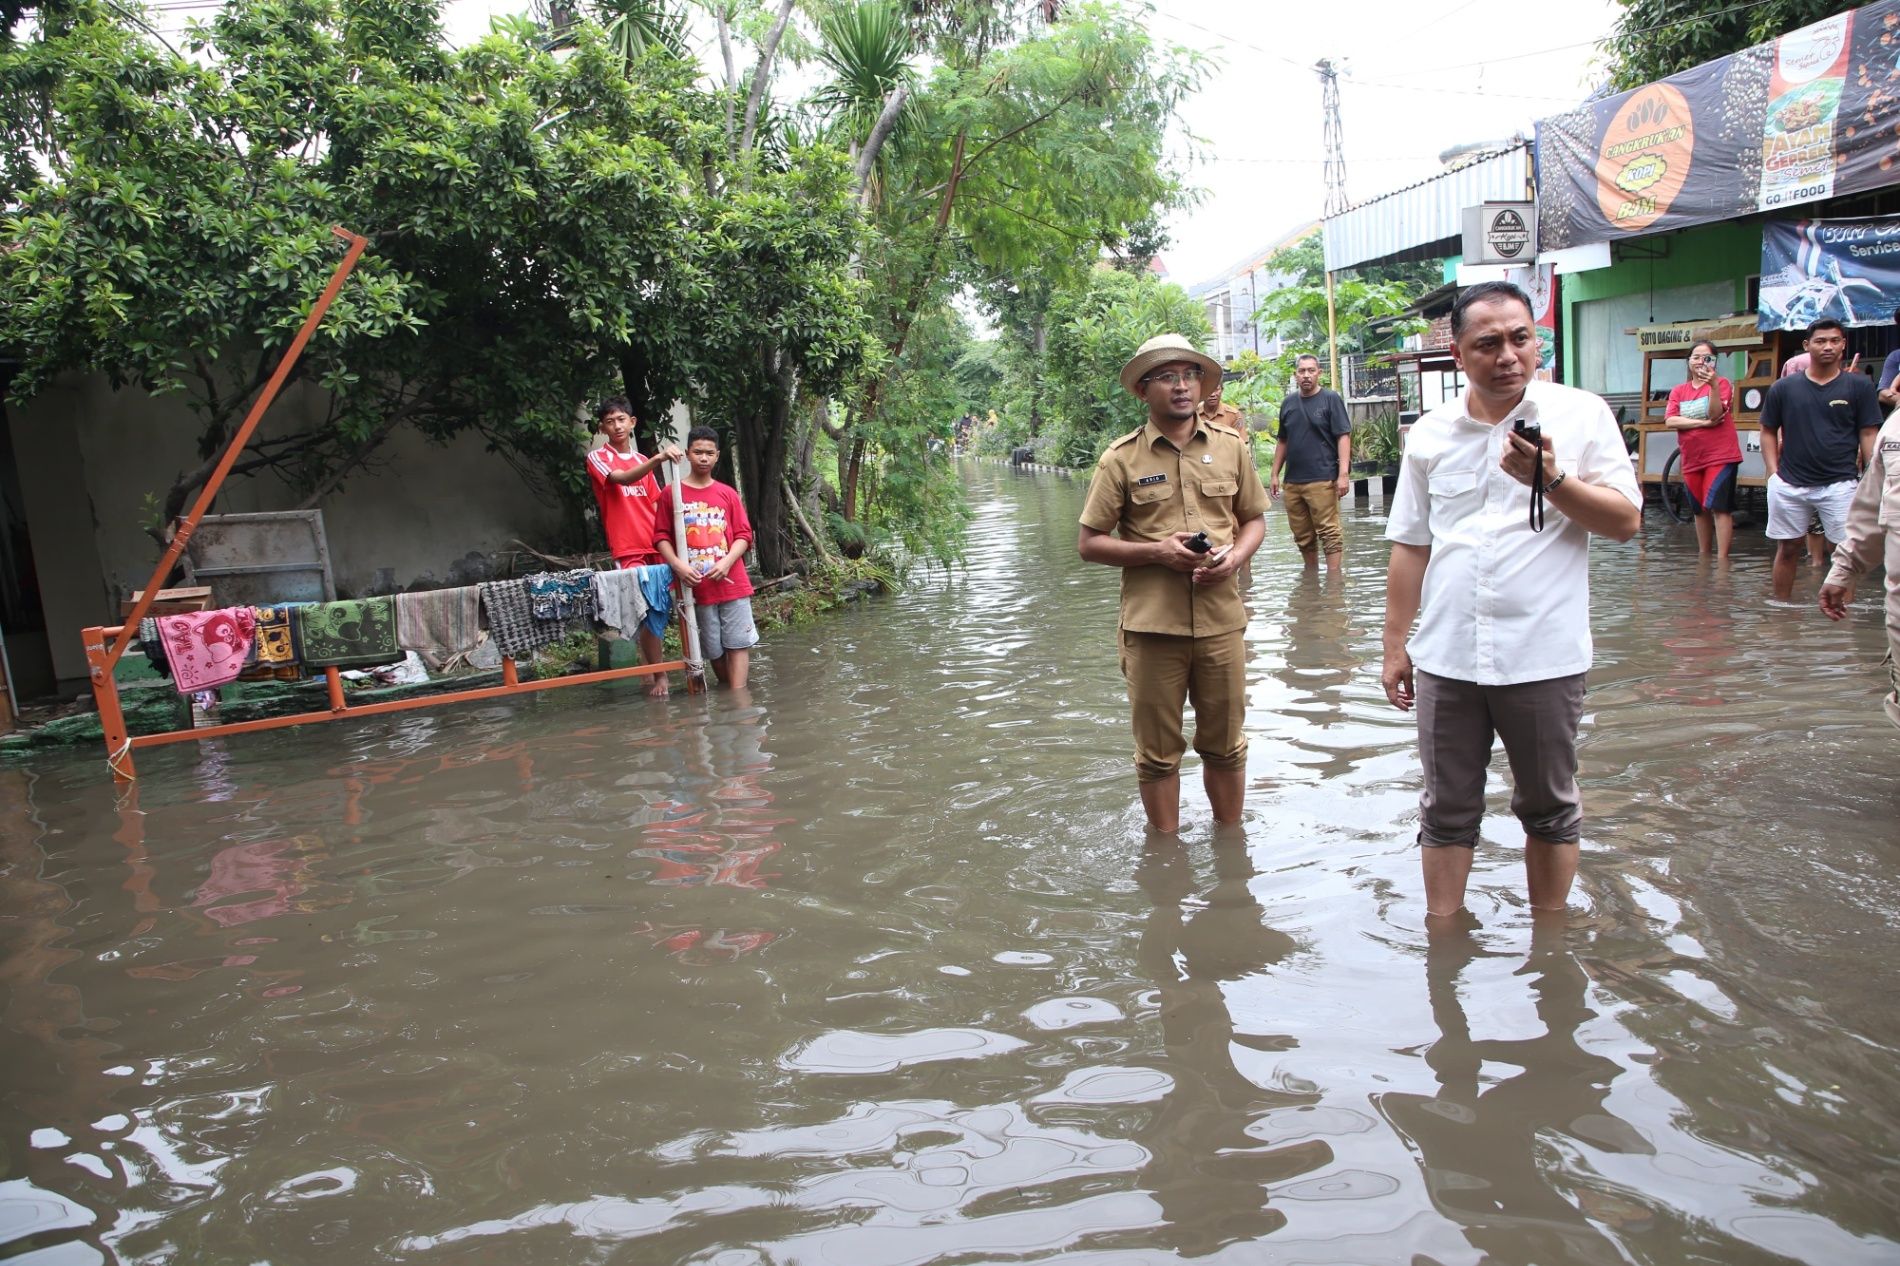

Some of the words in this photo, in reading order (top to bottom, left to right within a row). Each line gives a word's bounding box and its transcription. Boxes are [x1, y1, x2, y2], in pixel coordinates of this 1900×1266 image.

[1771, 121, 1832, 157] AYAM
[1766, 143, 1832, 173] GEPREK
[1626, 163, 1656, 181] KOPI
[1766, 194, 1781, 205] GO
[1793, 184, 1826, 200] FOOD
[1616, 195, 1657, 220] BJM
[1849, 240, 1900, 257] Service
[1640, 331, 1657, 346] SOTO
[1684, 330, 1691, 343] &
